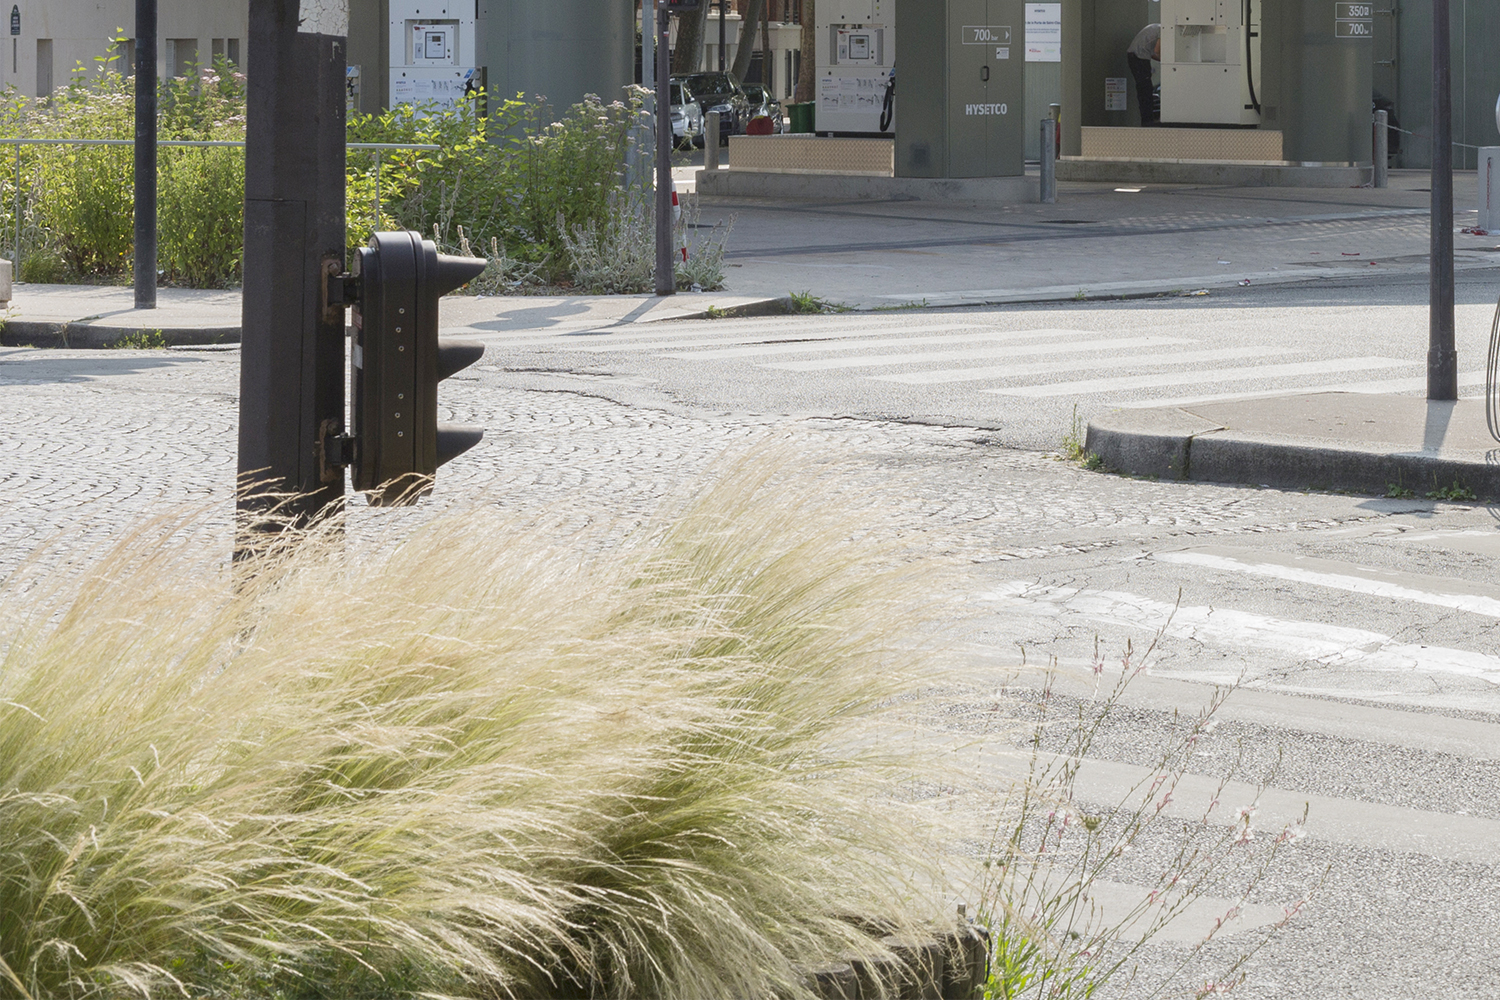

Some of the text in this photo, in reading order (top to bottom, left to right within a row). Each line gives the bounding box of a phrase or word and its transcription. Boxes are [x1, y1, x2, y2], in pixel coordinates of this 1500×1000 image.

[1348, 5, 1364, 17] 350
[973, 29, 991, 41] 700
[1348, 23, 1364, 35] 700
[965, 103, 1008, 116] HYSETCO
